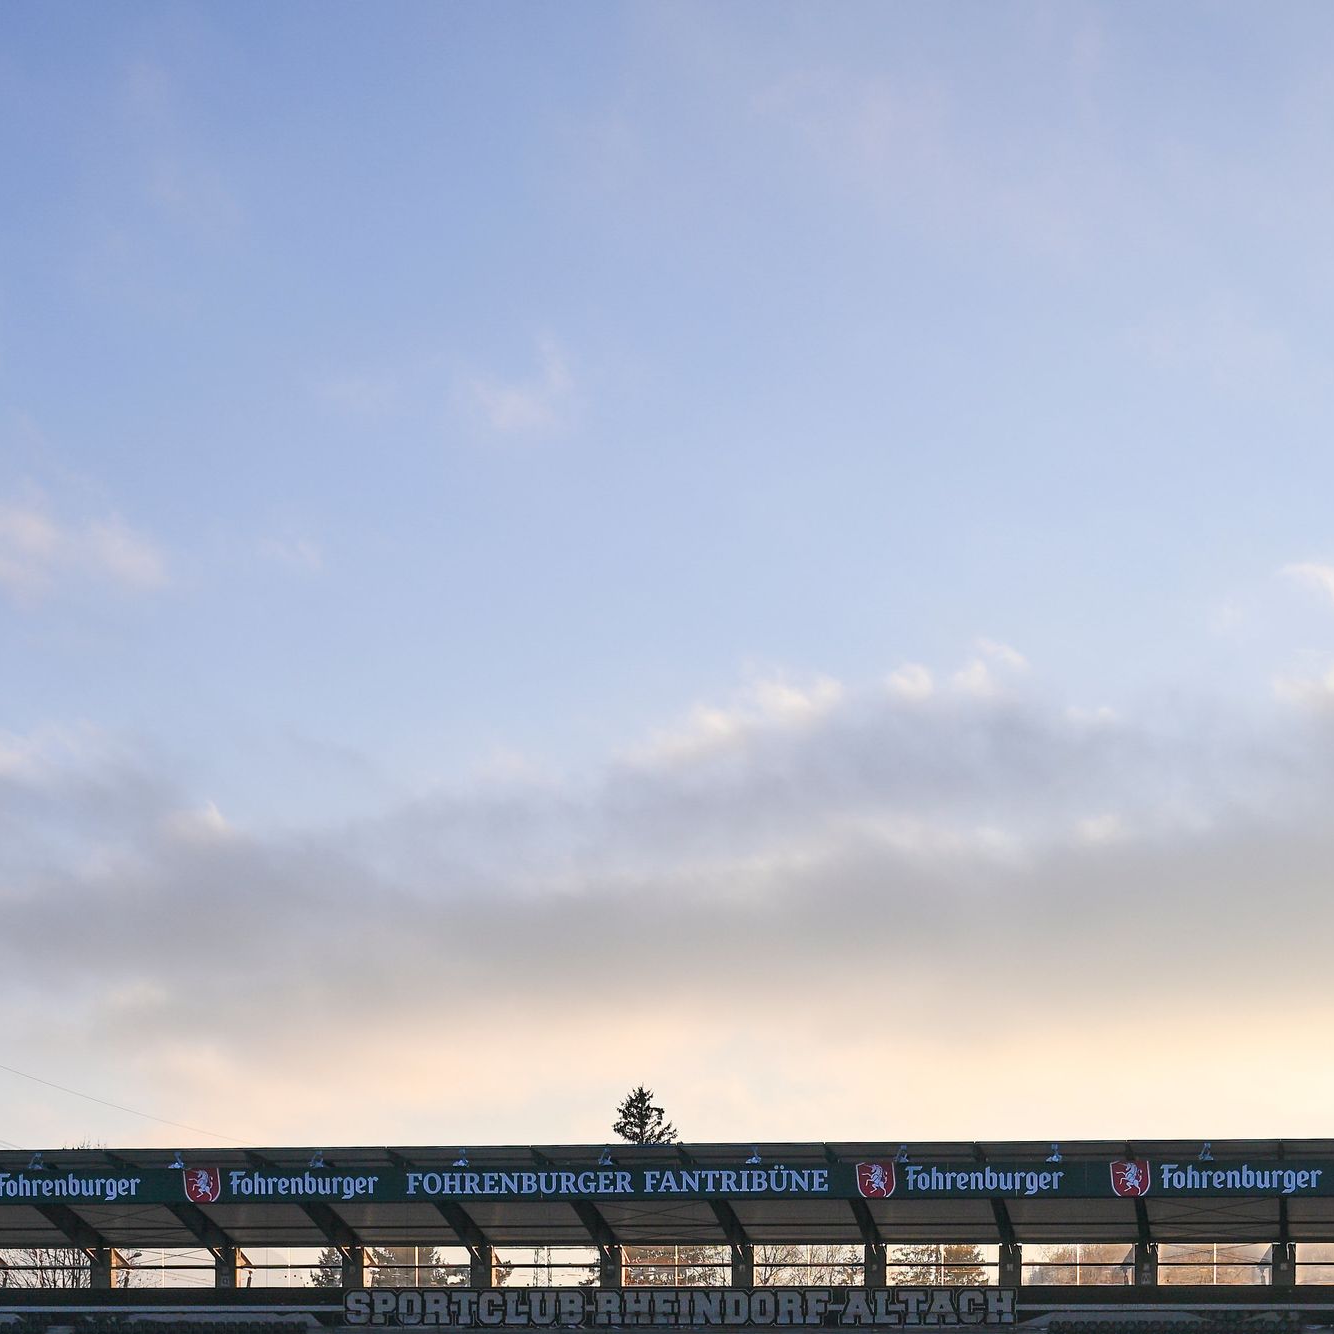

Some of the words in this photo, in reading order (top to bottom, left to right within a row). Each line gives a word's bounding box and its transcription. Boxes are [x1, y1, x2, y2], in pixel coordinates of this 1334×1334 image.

[229, 1170, 379, 1200] Fohrenburger
[406, 1171, 634, 1195] FOHRENBURGER
[643, 1165, 829, 1193] FANTRIBÜNE
[905, 1165, 1065, 1195] Fohrenburger
[1160, 1164, 1323, 1194] Fohrenburger
[345, 1290, 586, 1325] SPORTCLUB
[593, 1290, 833, 1325] RHEINDORF
[839, 1290, 1017, 1325] ALTACH
